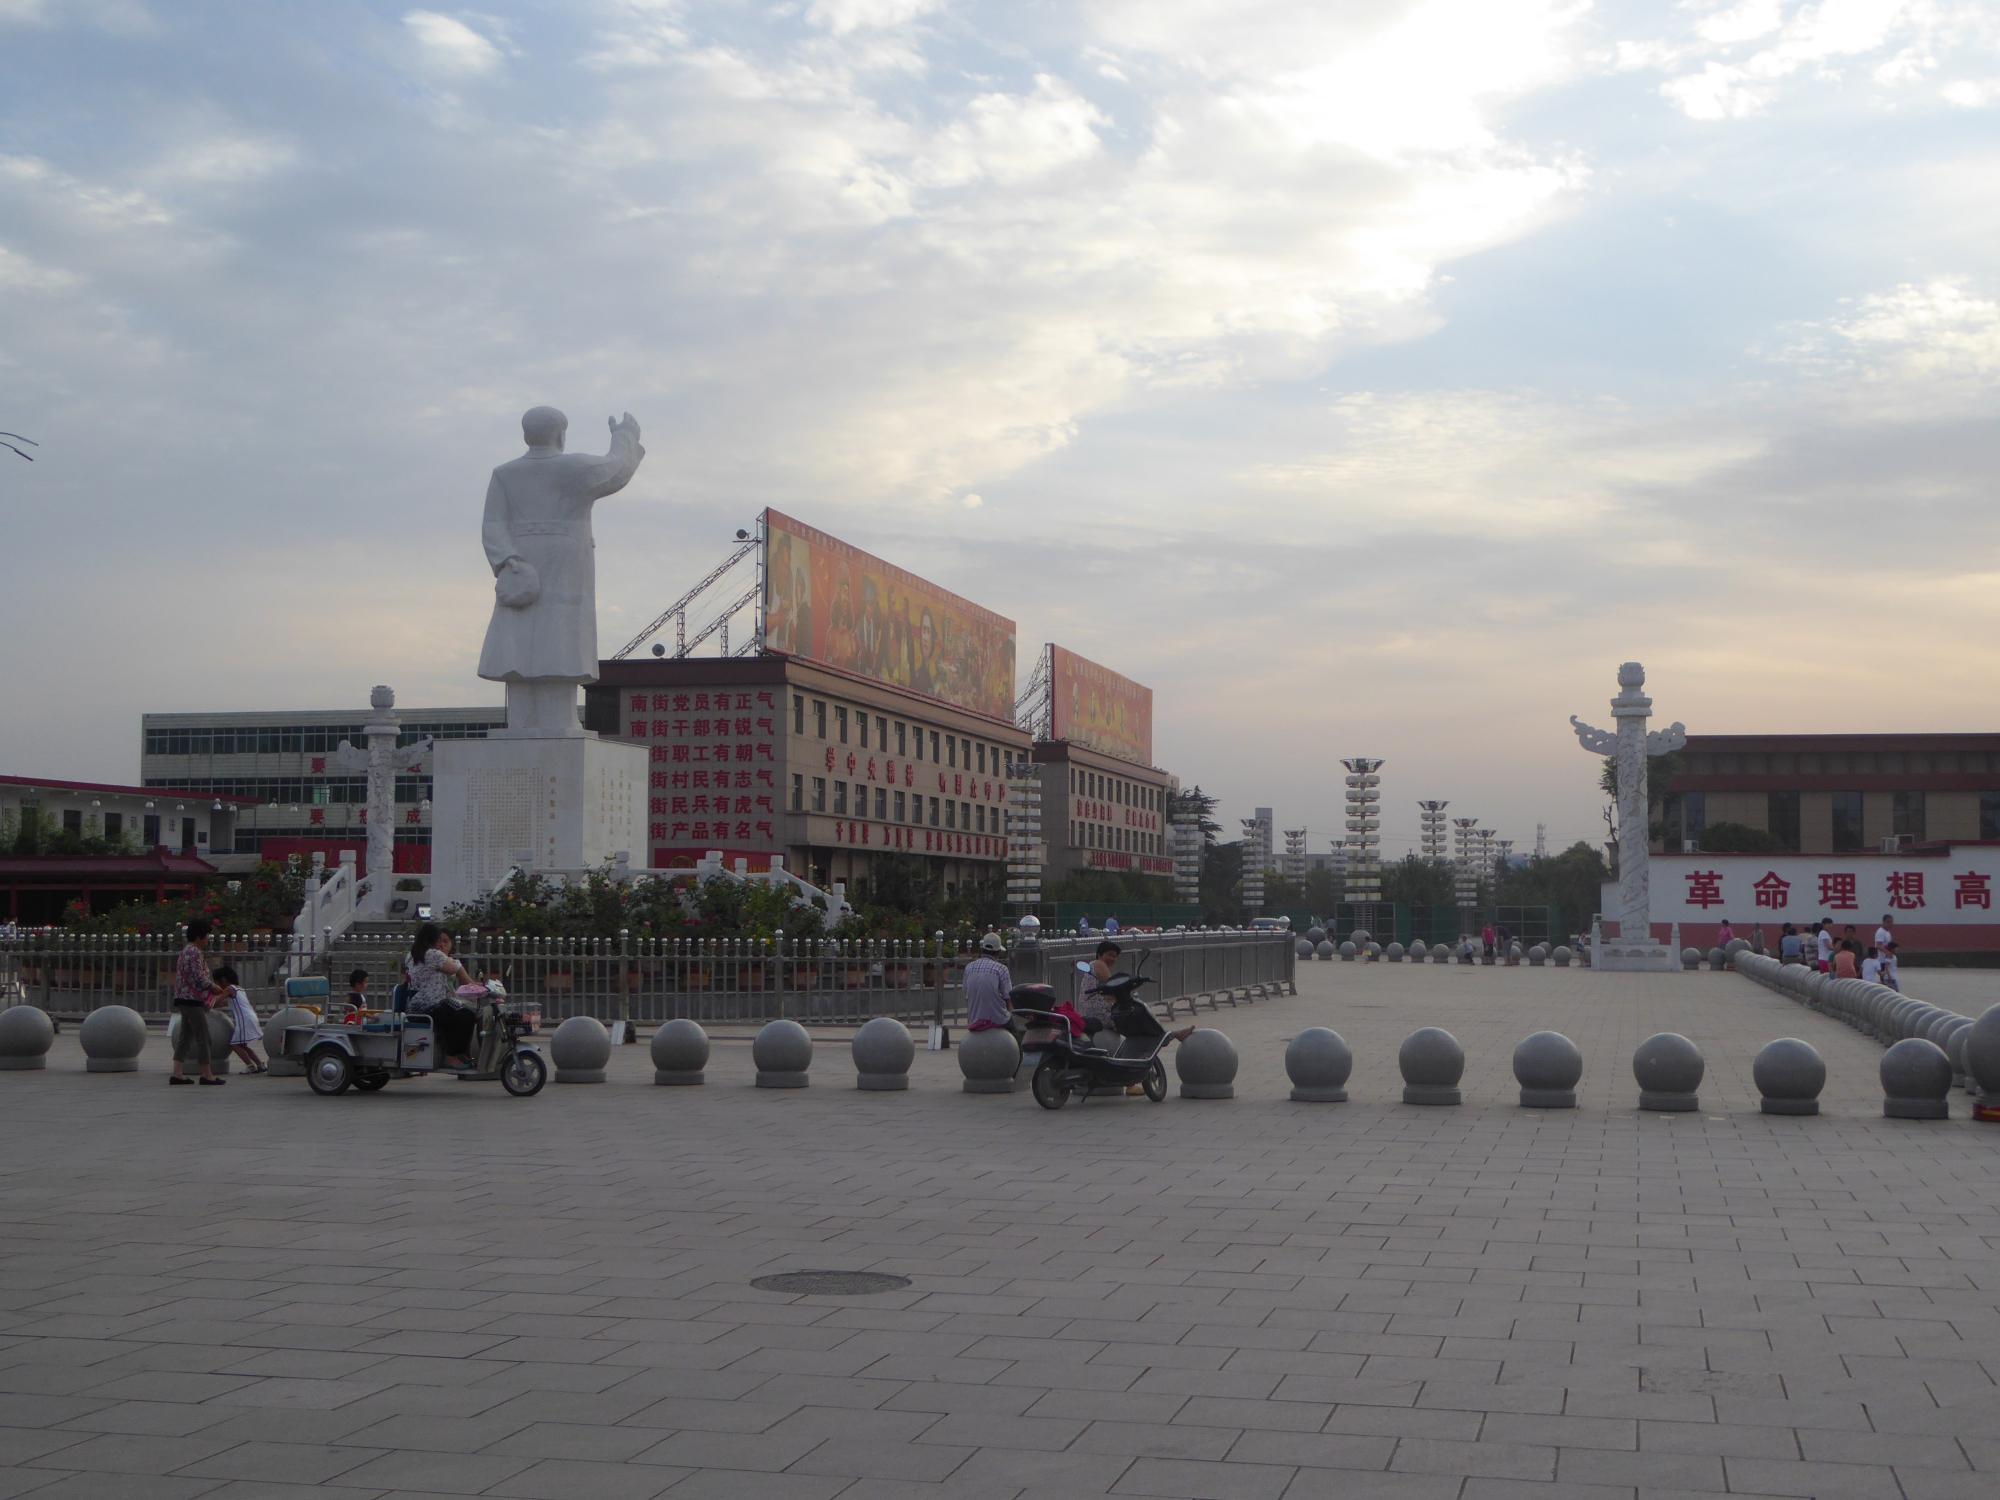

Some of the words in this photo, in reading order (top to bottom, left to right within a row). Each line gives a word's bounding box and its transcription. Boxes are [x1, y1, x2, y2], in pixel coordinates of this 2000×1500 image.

[630, 691, 775, 712] 南街党员有正气
[630, 717, 775, 738] 南街干部有锐气
[825, 745, 914, 788] 学中央精神
[1685, 870, 1991, 910] 革命理想高
